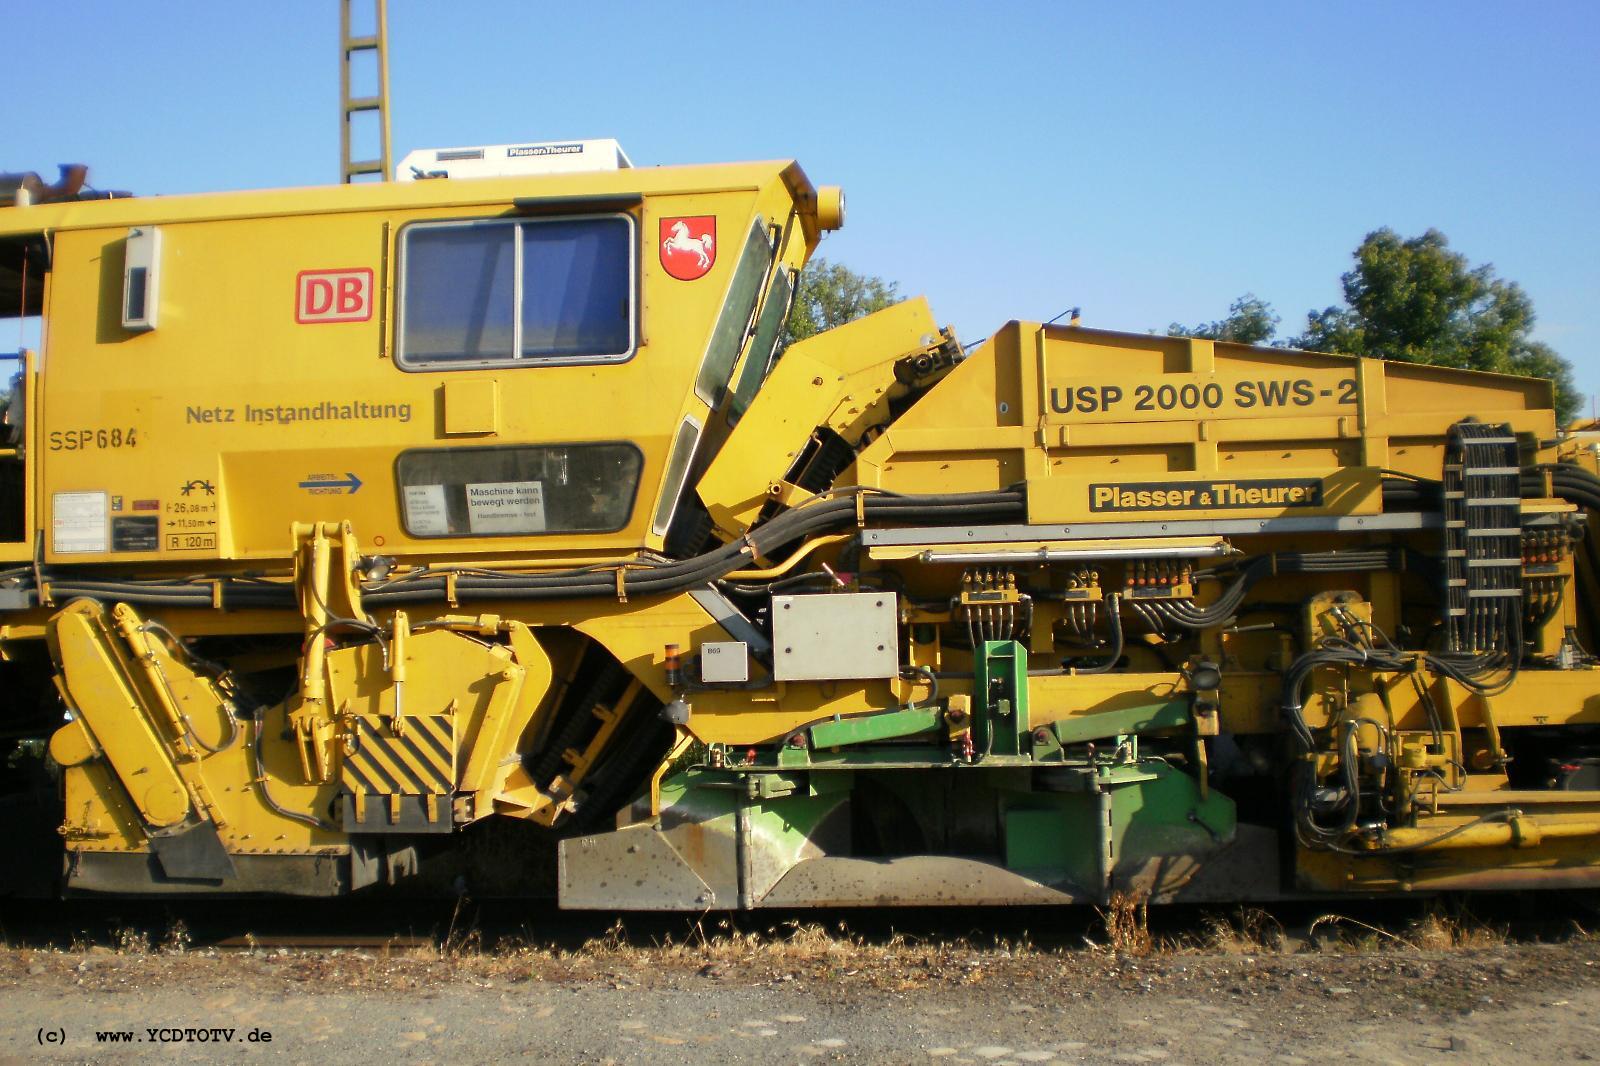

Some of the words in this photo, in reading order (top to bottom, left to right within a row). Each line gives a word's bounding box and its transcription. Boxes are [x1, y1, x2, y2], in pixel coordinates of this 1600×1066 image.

[305, 277, 363, 315] DB
[1051, 386, 1123, 413] USP
[1134, 383, 1223, 410] 2000
[186, 406, 235, 424] Netz
[245, 401, 412, 424] Instandhaltung
[50, 428, 137, 451] SSP684
[470, 488, 514, 496] Maschine
[516, 487, 539, 495] kann
[471, 499, 505, 507] bewegt
[507, 497, 540, 505] werden
[1095, 486, 1195, 508] Plasser
[1212, 483, 1317, 504] Theurer
[171, 537, 179, 547] R
